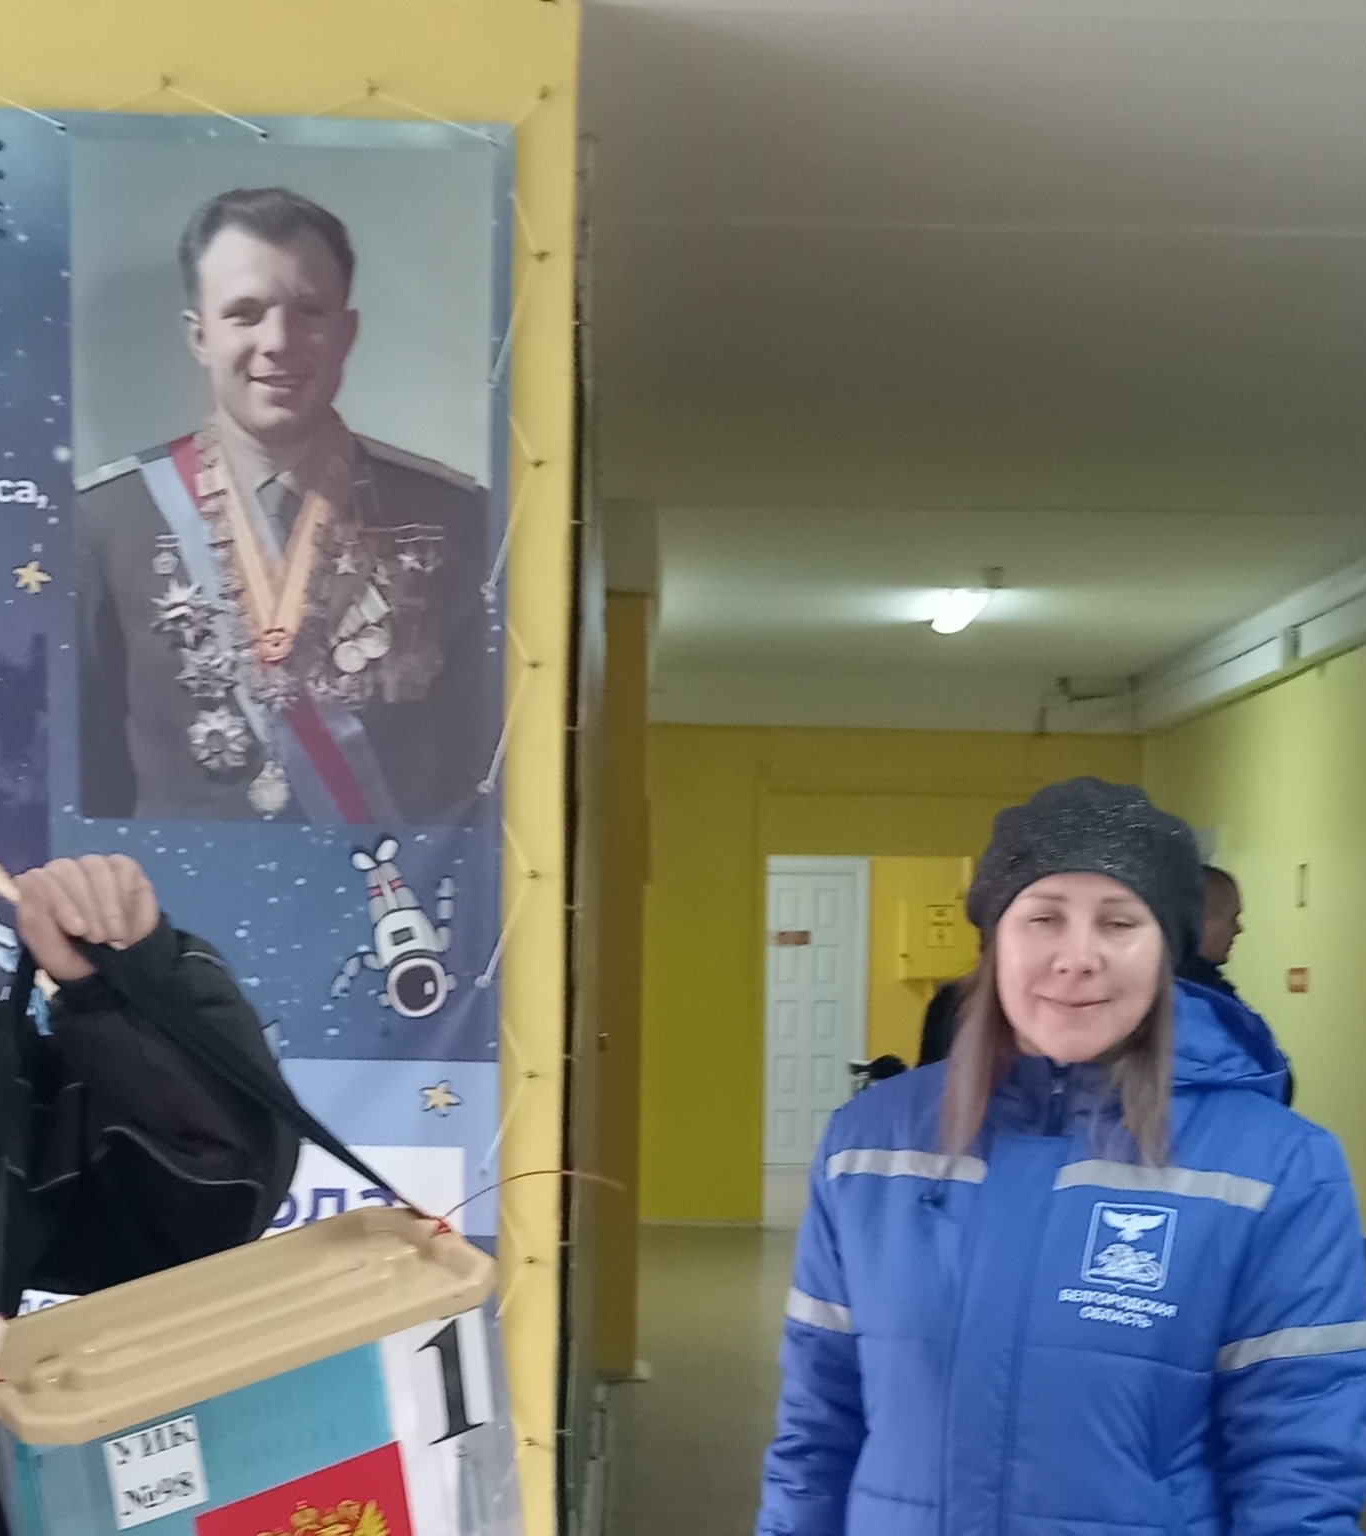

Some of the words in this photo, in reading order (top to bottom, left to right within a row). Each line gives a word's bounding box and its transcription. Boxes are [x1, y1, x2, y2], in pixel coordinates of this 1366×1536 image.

[1078, 1305, 1154, 1329] ОБЛАСТЬ
[414, 1317, 486, 1446] 1
[109, 1418, 196, 1466] УИК
